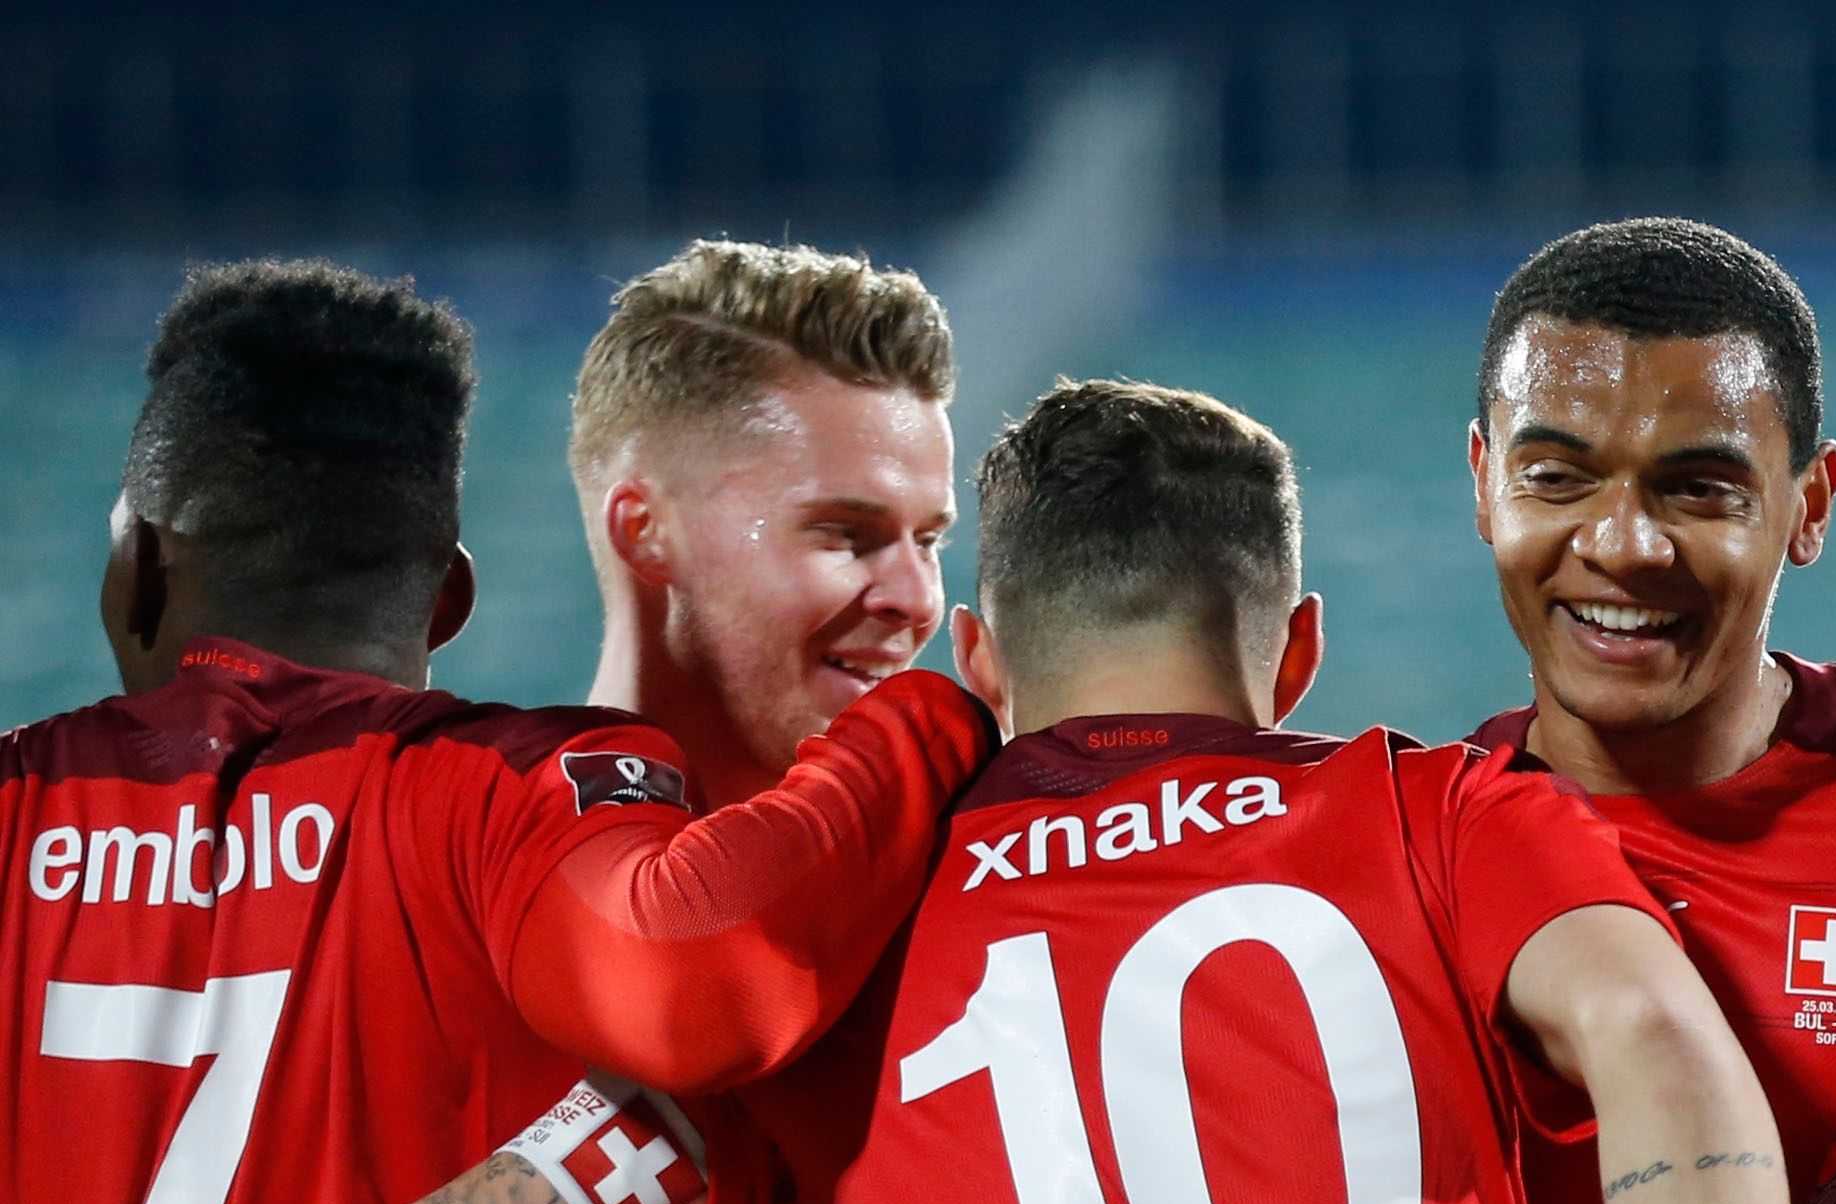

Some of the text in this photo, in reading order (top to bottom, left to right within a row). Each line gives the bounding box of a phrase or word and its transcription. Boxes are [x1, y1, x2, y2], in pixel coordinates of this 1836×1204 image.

[1087, 725, 1170, 749] suisse
[29, 793, 336, 909] embolo
[1794, 1012, 1827, 1031] BUL
